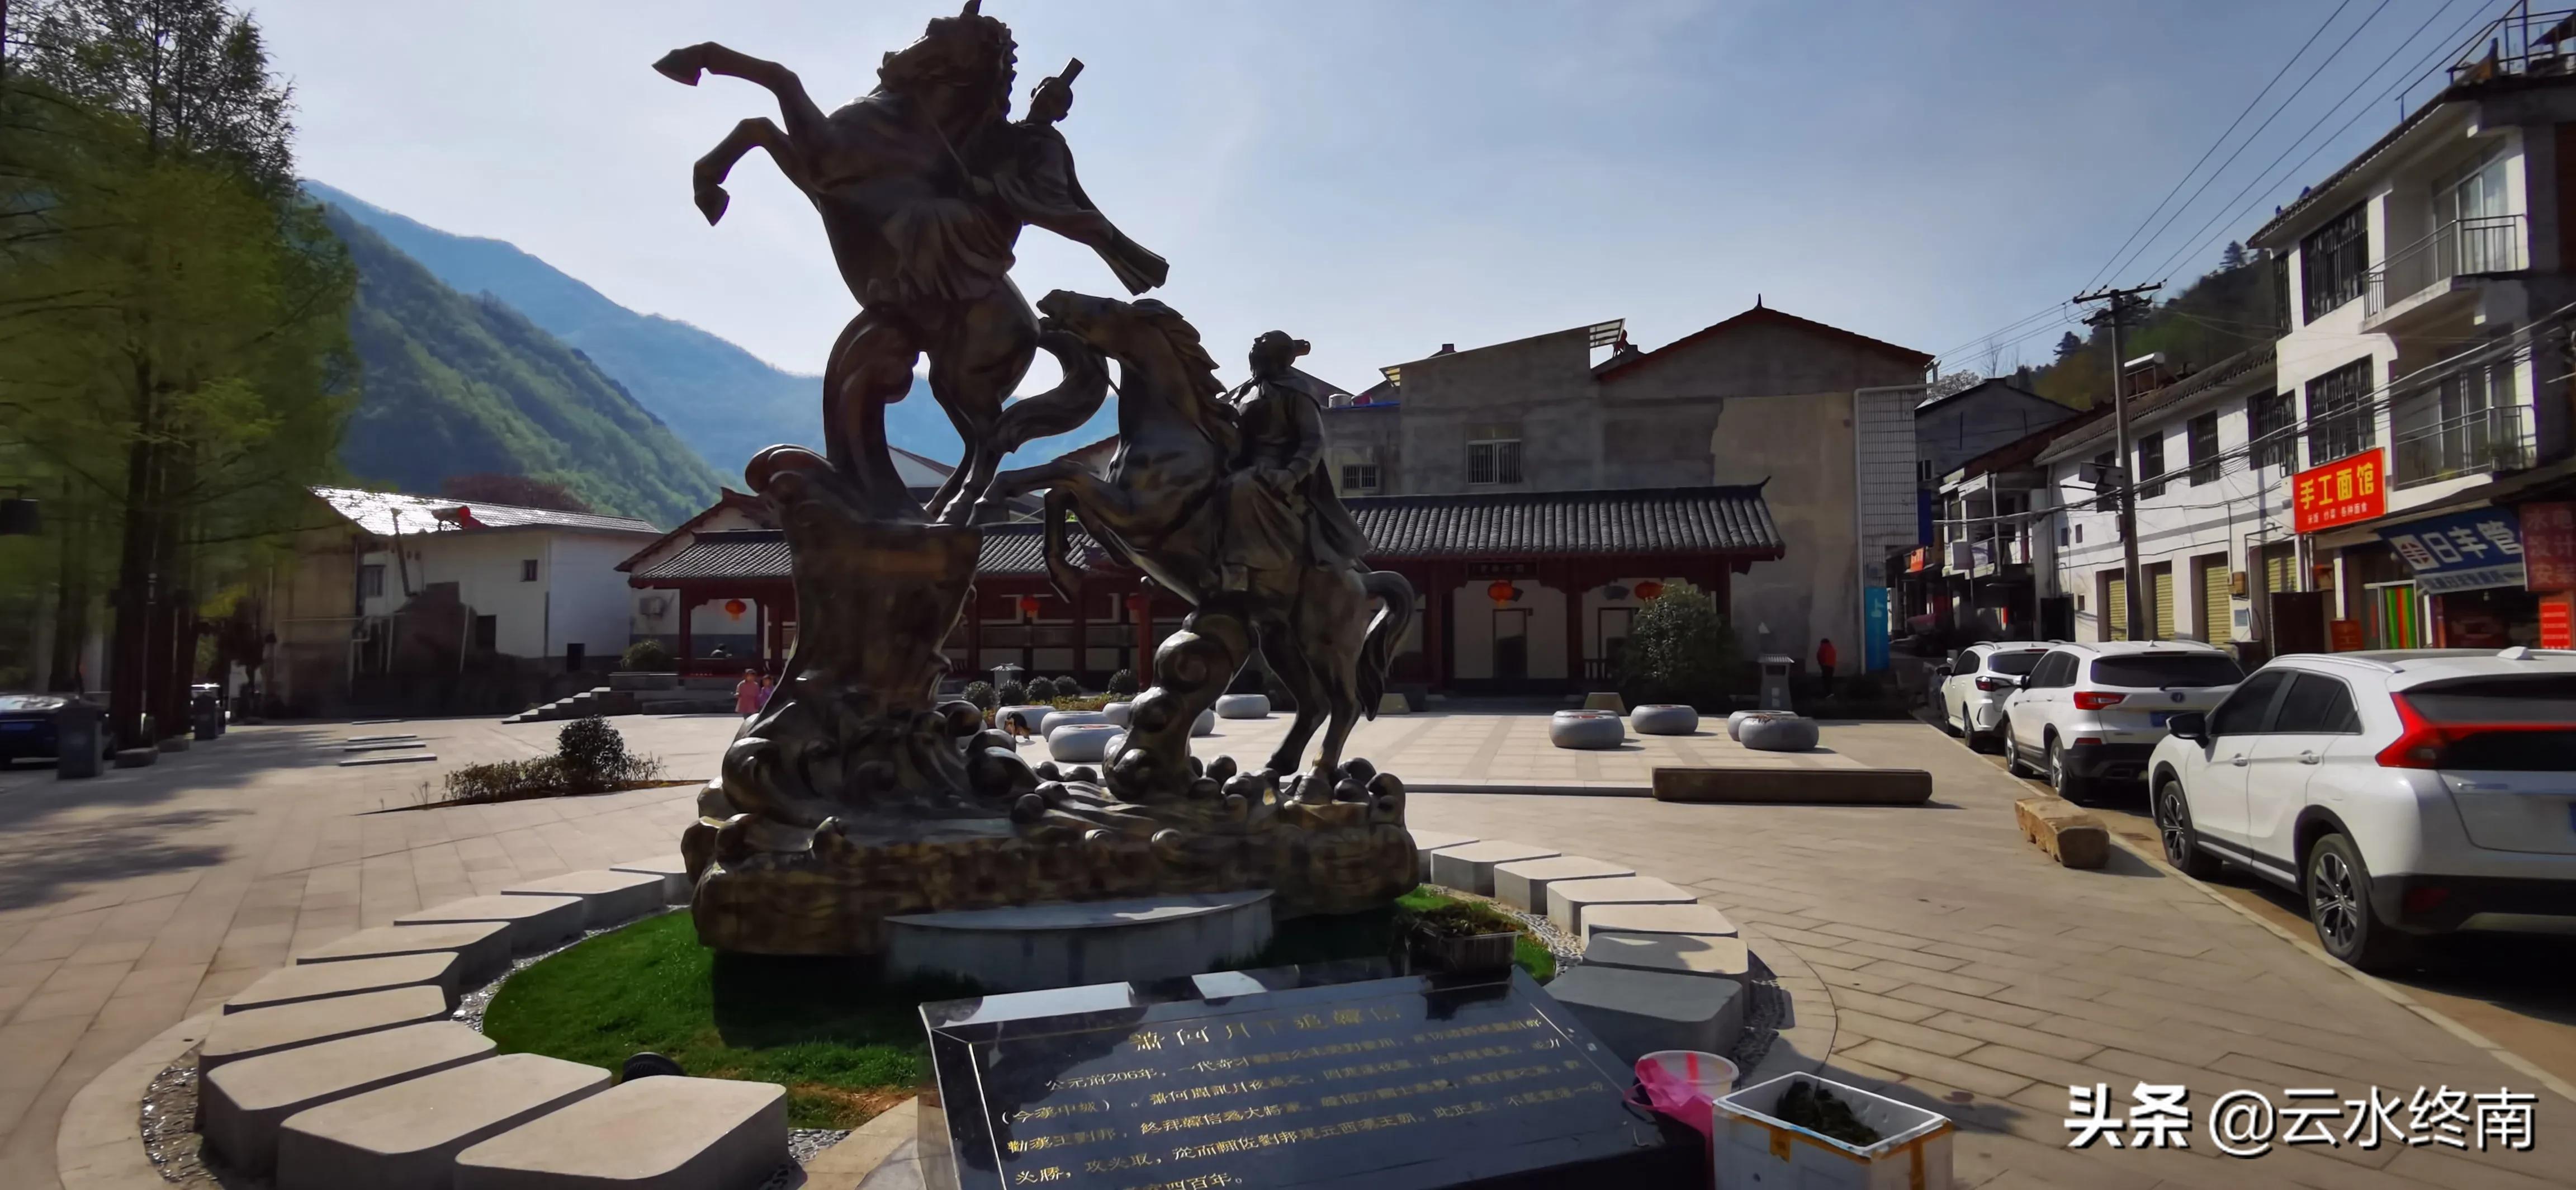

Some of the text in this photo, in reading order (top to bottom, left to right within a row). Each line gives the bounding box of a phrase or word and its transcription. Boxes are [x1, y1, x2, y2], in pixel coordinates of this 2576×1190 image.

[2300, 462, 2374, 509] 手工面馆
[2422, 521, 2523, 563] 日丰管
